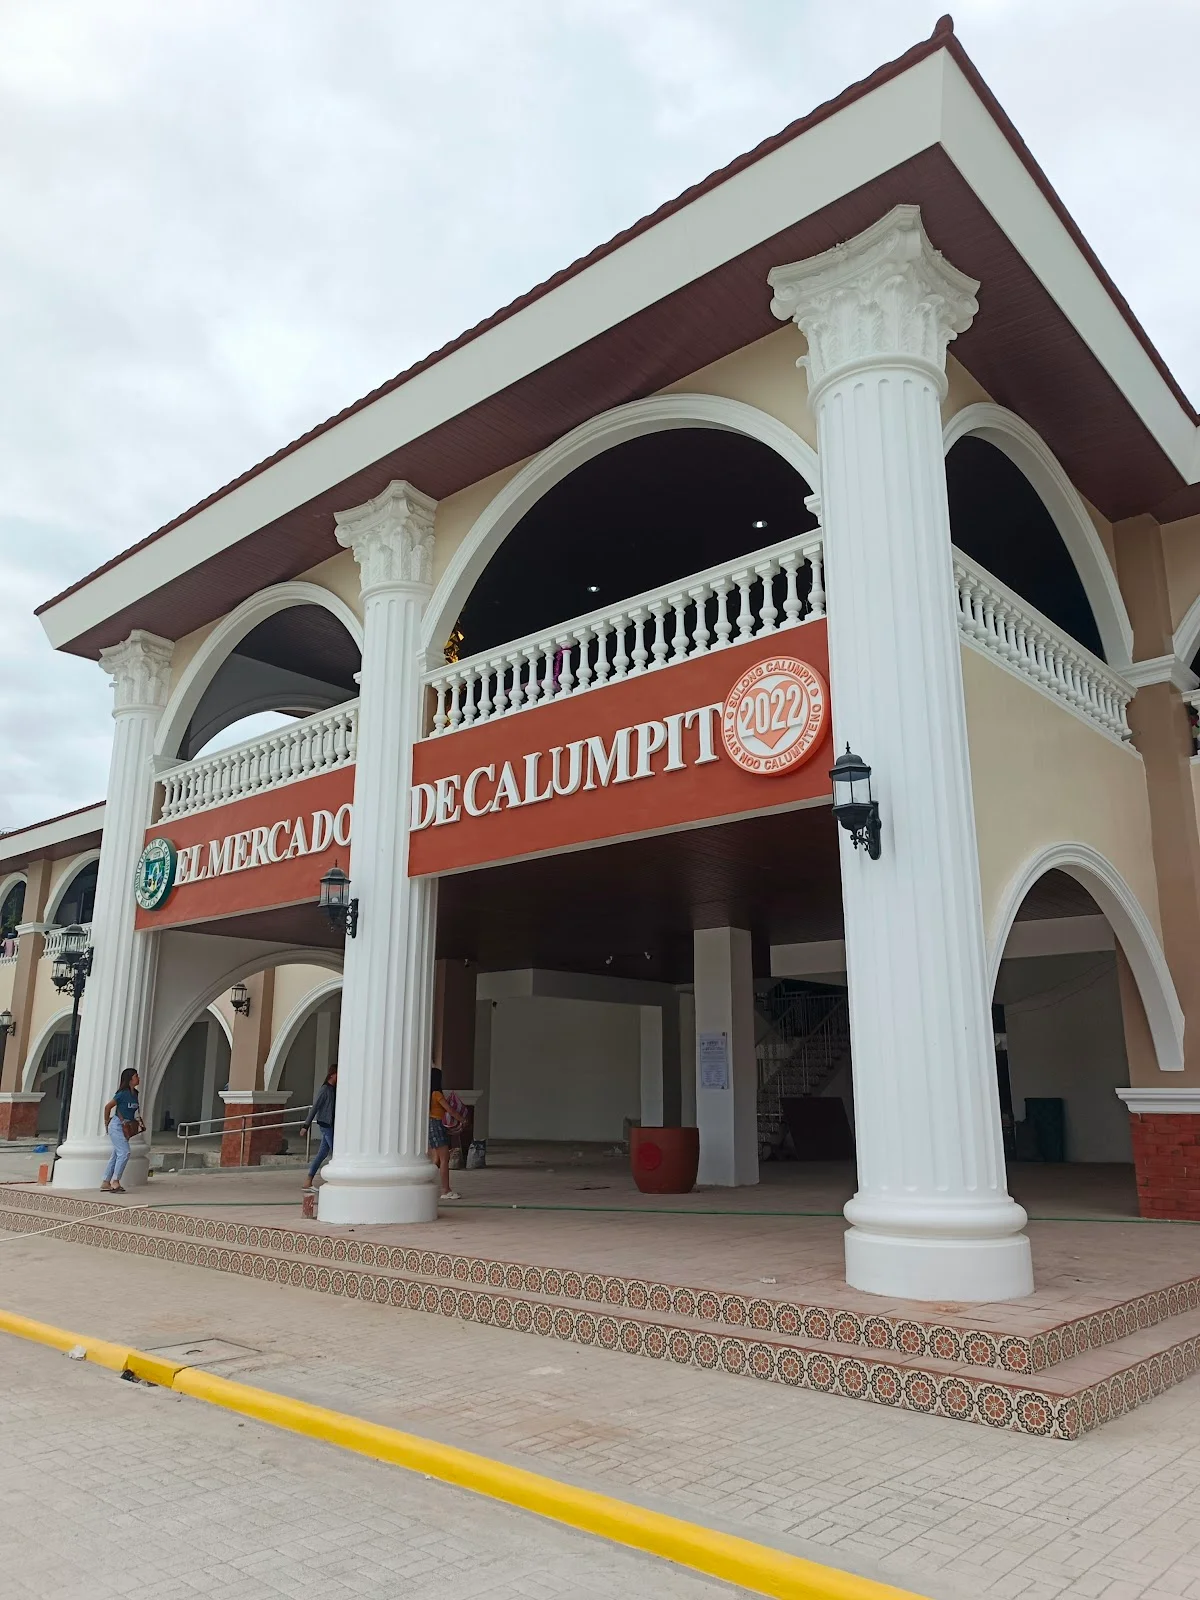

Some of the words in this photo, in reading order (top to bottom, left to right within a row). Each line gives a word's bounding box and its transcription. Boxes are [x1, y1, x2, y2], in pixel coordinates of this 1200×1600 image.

[728, 666, 764, 709] SULONG
[765, 660, 816, 687] CALUMPIT
[740, 684, 803, 739] 2022
[408, 774, 461, 832] DE
[463, 702, 725, 818] CALUMPIT
[724, 724, 740, 757] TAAS
[739, 752, 762, 770] NOO
[763, 702, 822, 771] CALUMPITENO
[203, 803, 354, 878] MERCADO
